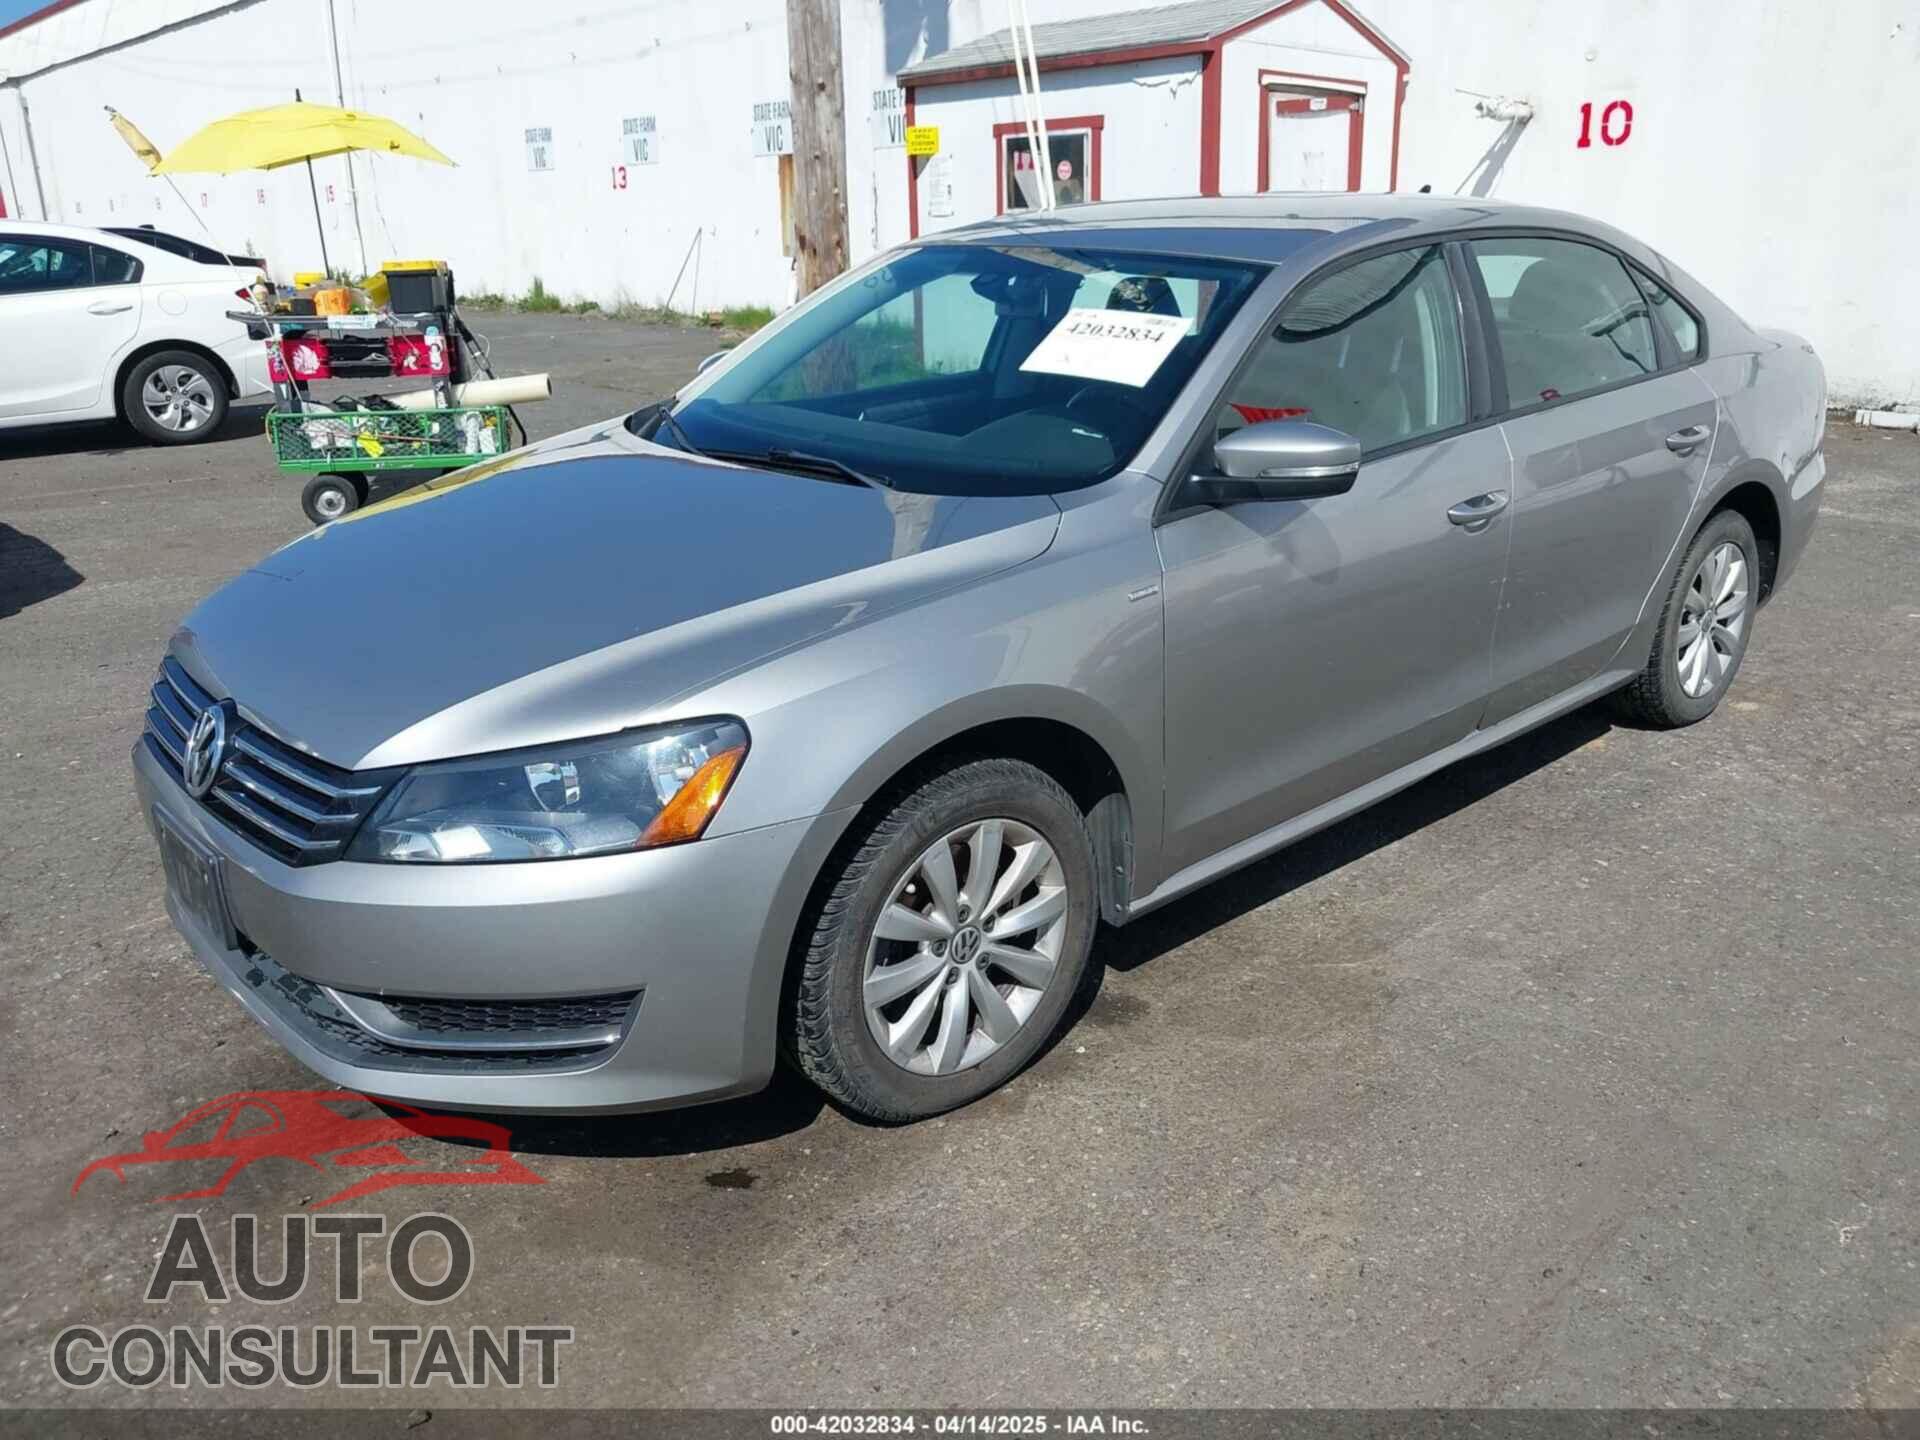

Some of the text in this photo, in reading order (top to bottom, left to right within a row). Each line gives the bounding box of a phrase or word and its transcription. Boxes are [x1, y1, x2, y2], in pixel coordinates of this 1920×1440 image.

[872, 89, 896, 110] STATE
[753, 103, 772, 121] STATE
[623, 115, 656, 134] STATE FARM
[1577, 100, 1633, 148] 10
[632, 138, 648, 161] VIC
[764, 125, 783, 152] VIC
[532, 146, 546, 168] VIC
[611, 166, 627, 189] 13
[1066, 322, 1165, 343] 42032834
